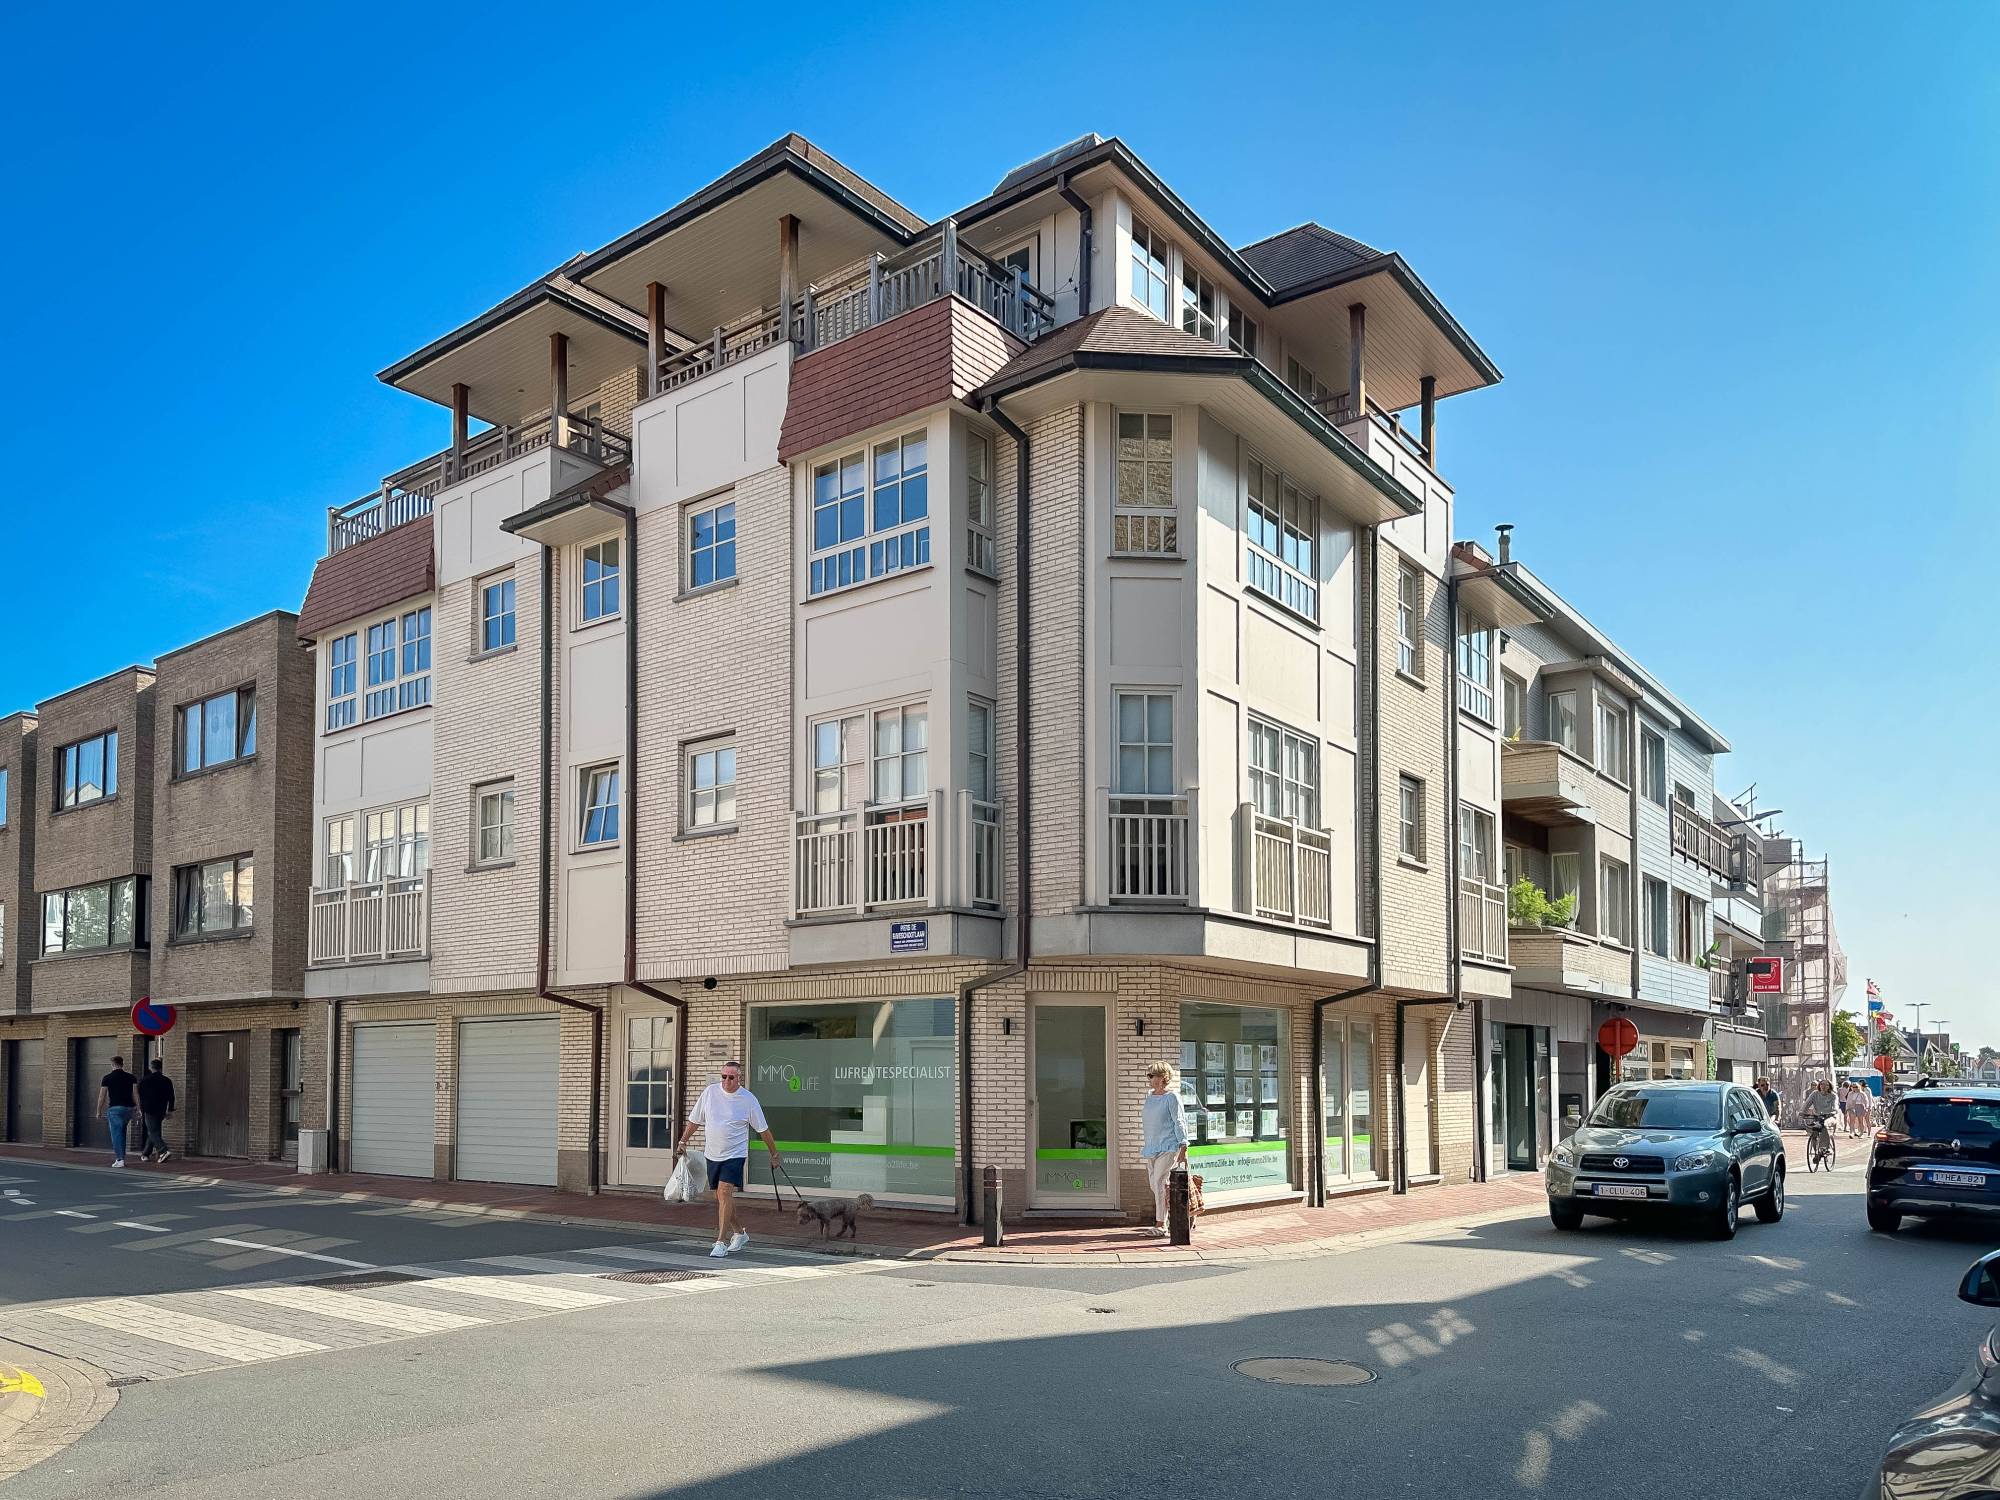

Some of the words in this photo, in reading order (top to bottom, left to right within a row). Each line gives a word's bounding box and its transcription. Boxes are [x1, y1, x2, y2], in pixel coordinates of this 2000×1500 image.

[757, 1064, 796, 1082] IMMO
[801, 1076, 821, 1091] LIFE
[834, 1065, 952, 1080] LIJFRENTESPECIALIST
[1600, 1186, 1646, 1196] 1-CLU-406
